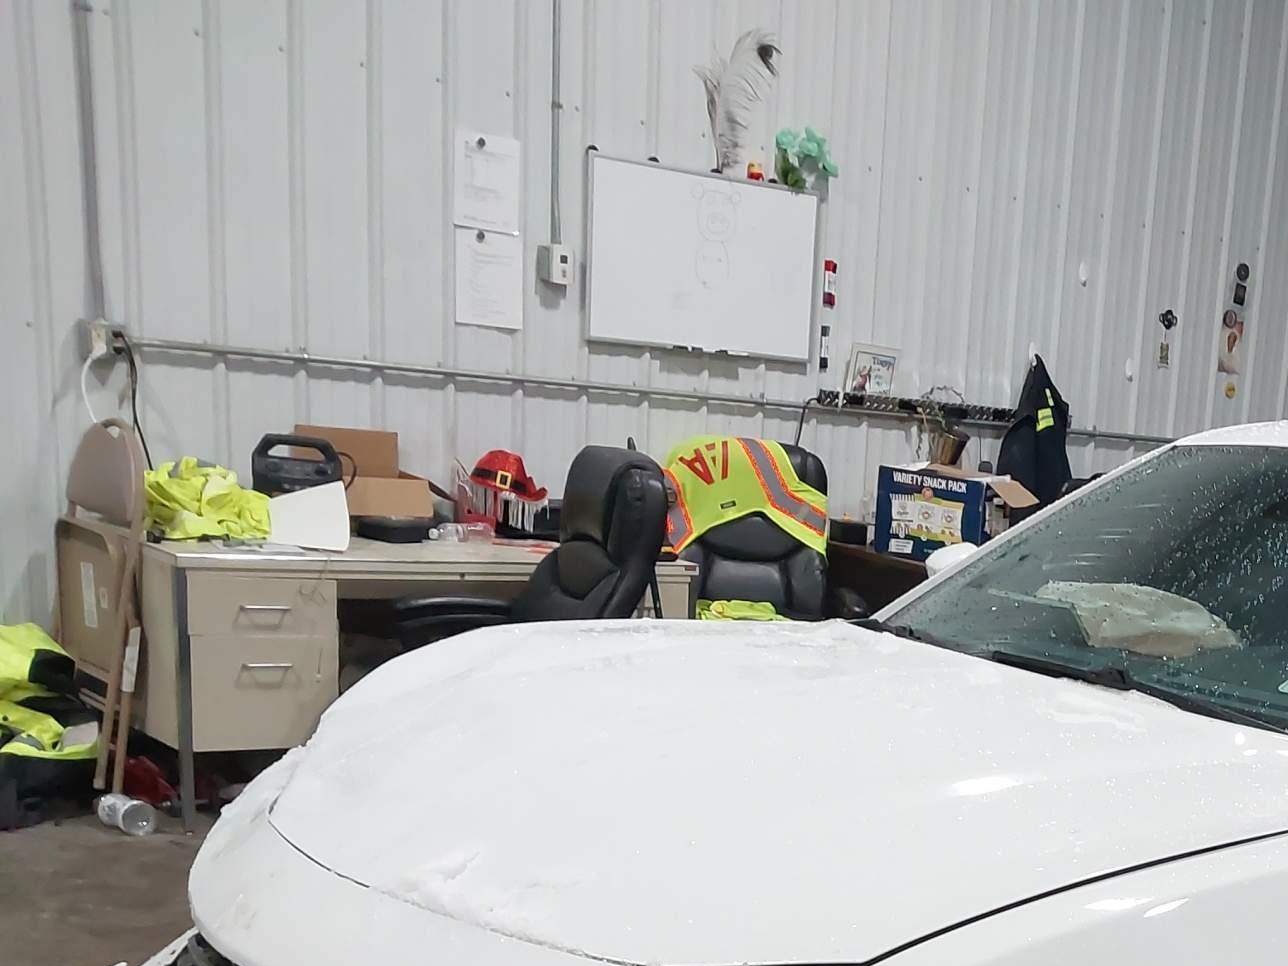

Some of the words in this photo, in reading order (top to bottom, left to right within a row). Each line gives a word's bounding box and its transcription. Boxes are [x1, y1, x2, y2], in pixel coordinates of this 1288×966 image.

[893, 471, 922, 486] VARIETY
[922, 476, 947, 491] SNACK
[948, 479, 968, 494] PACK
